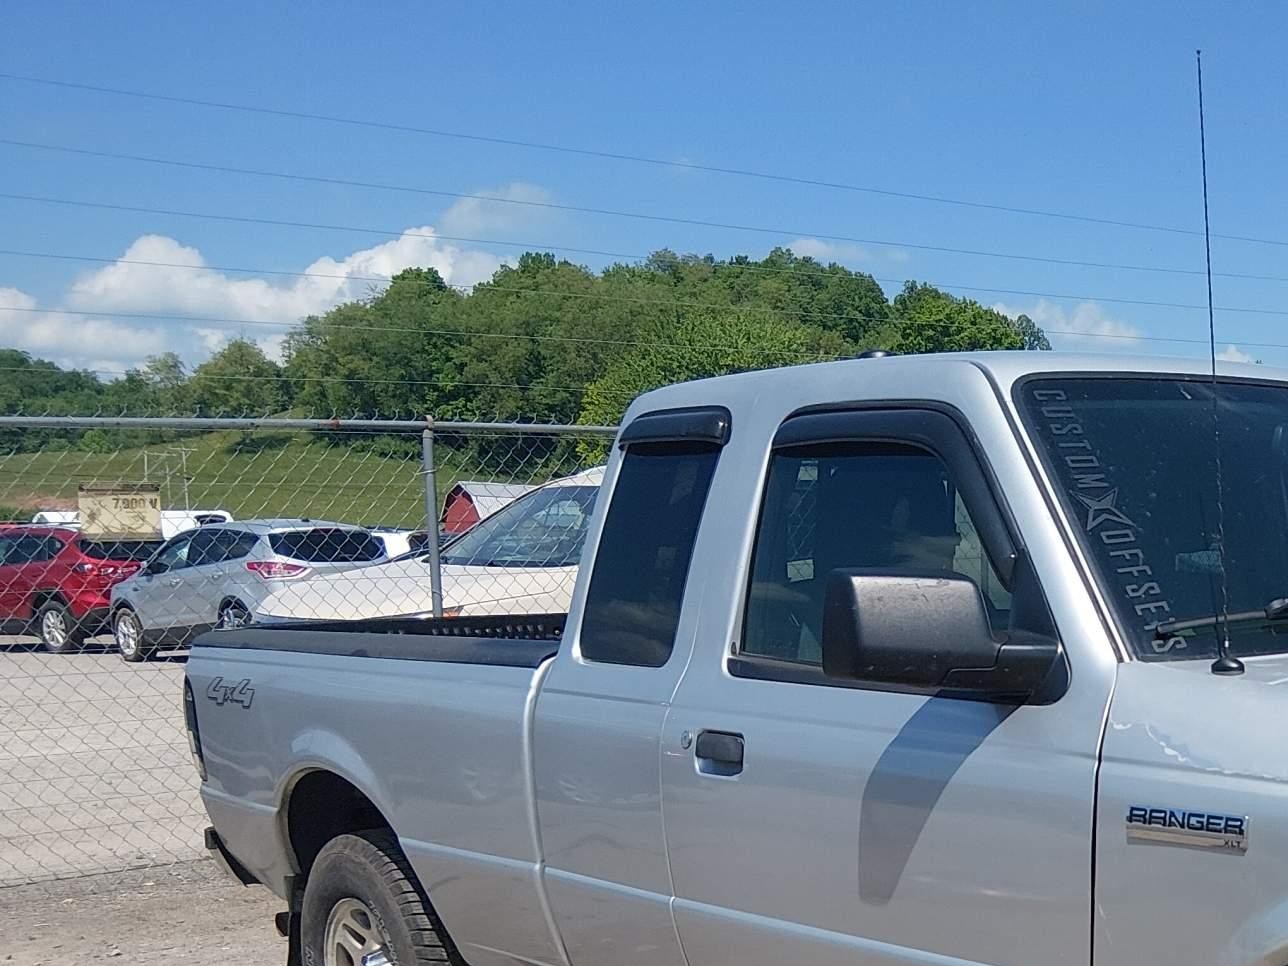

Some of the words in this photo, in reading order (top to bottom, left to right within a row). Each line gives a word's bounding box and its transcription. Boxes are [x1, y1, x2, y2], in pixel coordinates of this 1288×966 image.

[1033, 389, 1109, 488] CUSTOM
[207, 676, 256, 709] 4x4
[1127, 806, 1245, 835] RANGER
[1223, 839, 1241, 848] XLT
